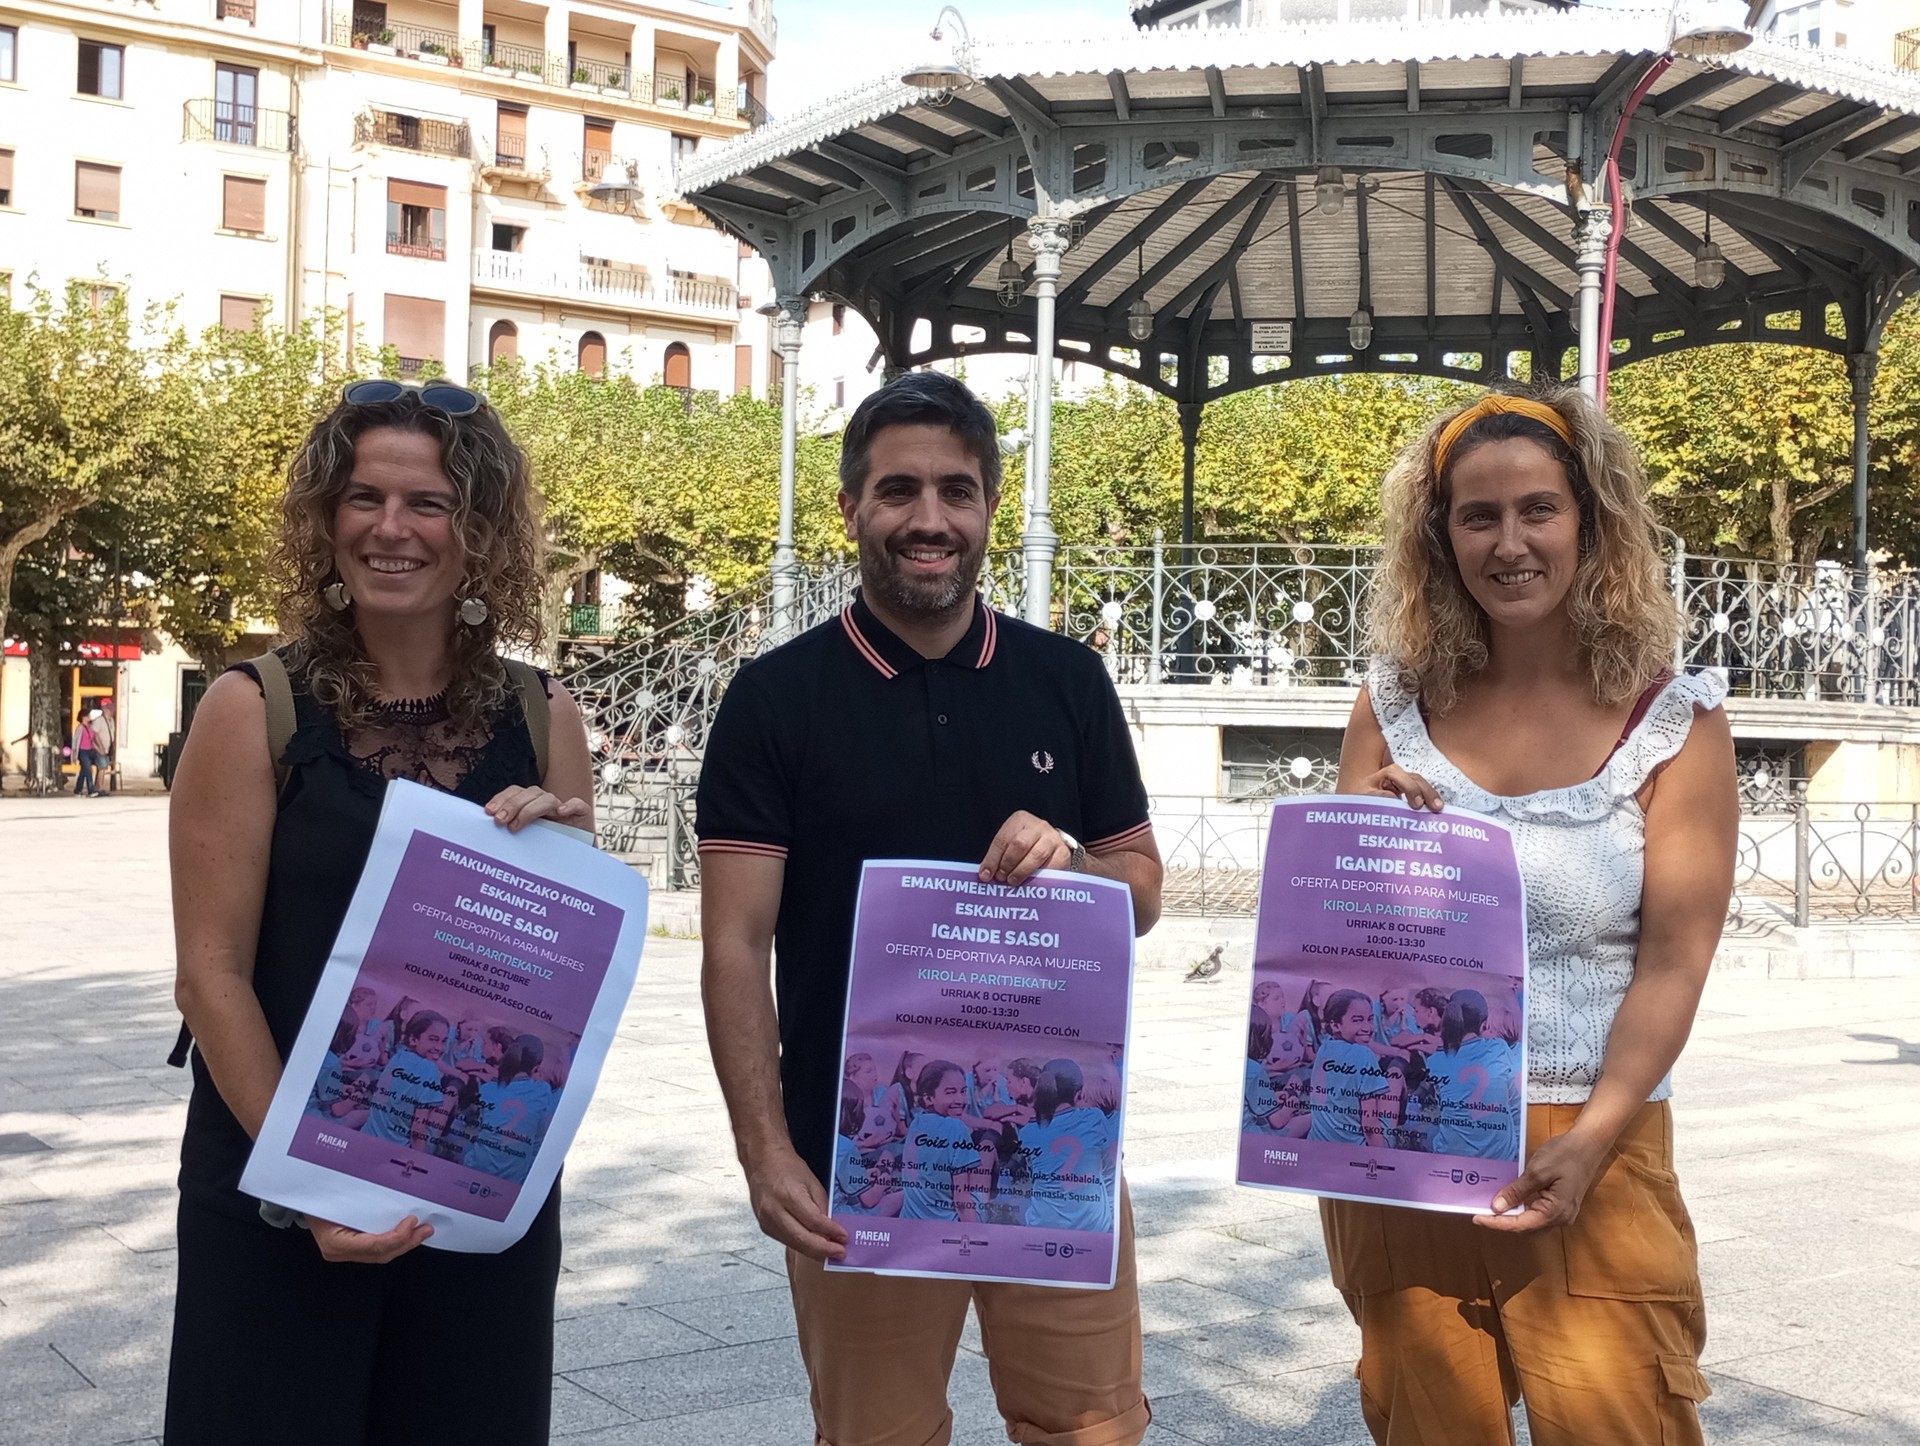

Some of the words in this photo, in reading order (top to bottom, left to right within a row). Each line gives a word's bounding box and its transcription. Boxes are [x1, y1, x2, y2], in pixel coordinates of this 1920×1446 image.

[1306, 812, 1449, 834] EMAKUMEENTZAKO
[1452, 824, 1490, 842] KIROL
[1358, 835, 1442, 854] ESKAINTZA
[1335, 855, 1405, 875] IGANDE
[1410, 861, 1461, 881] SASOI
[441, 848, 559, 901] EMAKUMEENTZAKO
[560, 894, 596, 916] KIROL
[901, 876, 1048, 899] EMAKUMEENTZAKO
[1050, 890, 1095, 904] KIROL
[1291, 876, 1338, 889] OFERTA
[1342, 880, 1411, 895] DEPORTIVA
[1414, 886, 1446, 899] PARA
[1449, 890, 1499, 907] MUJERES
[480, 883, 547, 917] ESKAINTZA
[955, 903, 1039, 921] ESKAINTZA
[1323, 899, 1372, 914] KIROLA
[1375, 903, 1468, 924] PAR(T)EKATUZ
[455, 895, 513, 926] IGANDE
[514, 918, 559, 943] SASOI
[1346, 919, 1386, 931] URRIAK
[1388, 922, 1395, 932] 8
[1397, 923, 1446, 936] OCTUBRE
[413, 903, 453, 924] OFERTA
[454, 917, 511, 944] DEPORTIVA
[512, 939, 538, 955] PARA
[540, 949, 585, 972] MUJERES
[931, 923, 1000, 944] IGANDE
[1005, 930, 1060, 948] SASOI
[1366, 934, 1426, 948] 10:00-13:30
[434, 930, 474, 951] KIROLA
[476, 945, 554, 980] PAR(T)EKATUZ
[886, 943, 934, 958] OFERTA
[937, 948, 1006, 964] DEPORTIVA
[1009, 955, 1042, 967] PARA
[1045, 957, 1101, 972] MUJERES
[1302, 944, 1338, 955] KOLON
[1341, 946, 1447, 965] PASEALEKUA/PASEO
[1450, 956, 1484, 969] COLÓN
[449, 951, 481, 969] URRIAK
[483, 963, 489, 972] 8
[490, 966, 530, 986] OCTUBRE
[461, 969, 510, 992] 10:00-13:30
[918, 968, 967, 983] KIROLA
[970, 972, 1067, 991] PAR(T)EKATUZ
[405, 963, 435, 979] KOLON
[436, 974, 524, 1011] PASEALEKUA/PASEO
[525, 1004, 553, 1021] COLÓN
[941, 988, 980, 1000] URRIAK
[983, 992, 989, 1001] 8
[992, 993, 1041, 1005] OCTUBRE
[960, 1004, 1020, 1018] 10:00-13:30
[895, 1013, 932, 1026] KOLON
[934, 1016, 1041, 1034] PASEALEKUA/PASEO
[1044, 1024, 1080, 1037] COLÓN
[392, 1068, 421, 1084] Goiz
[1322, 1060, 1357, 1075] Goiz
[1333, 1105, 1369, 1117] Parkour,
[1477, 1121, 1507, 1131] Squash
[318, 1133, 348, 1149] PAREAN
[915, 1134, 950, 1148] Goiz
[1264, 1150, 1298, 1161] PAREAN
[925, 1181, 961, 1193] Parkour,
[1069, 1193, 1100, 1202] Squash
[855, 1230, 890, 1242] PAREAN
